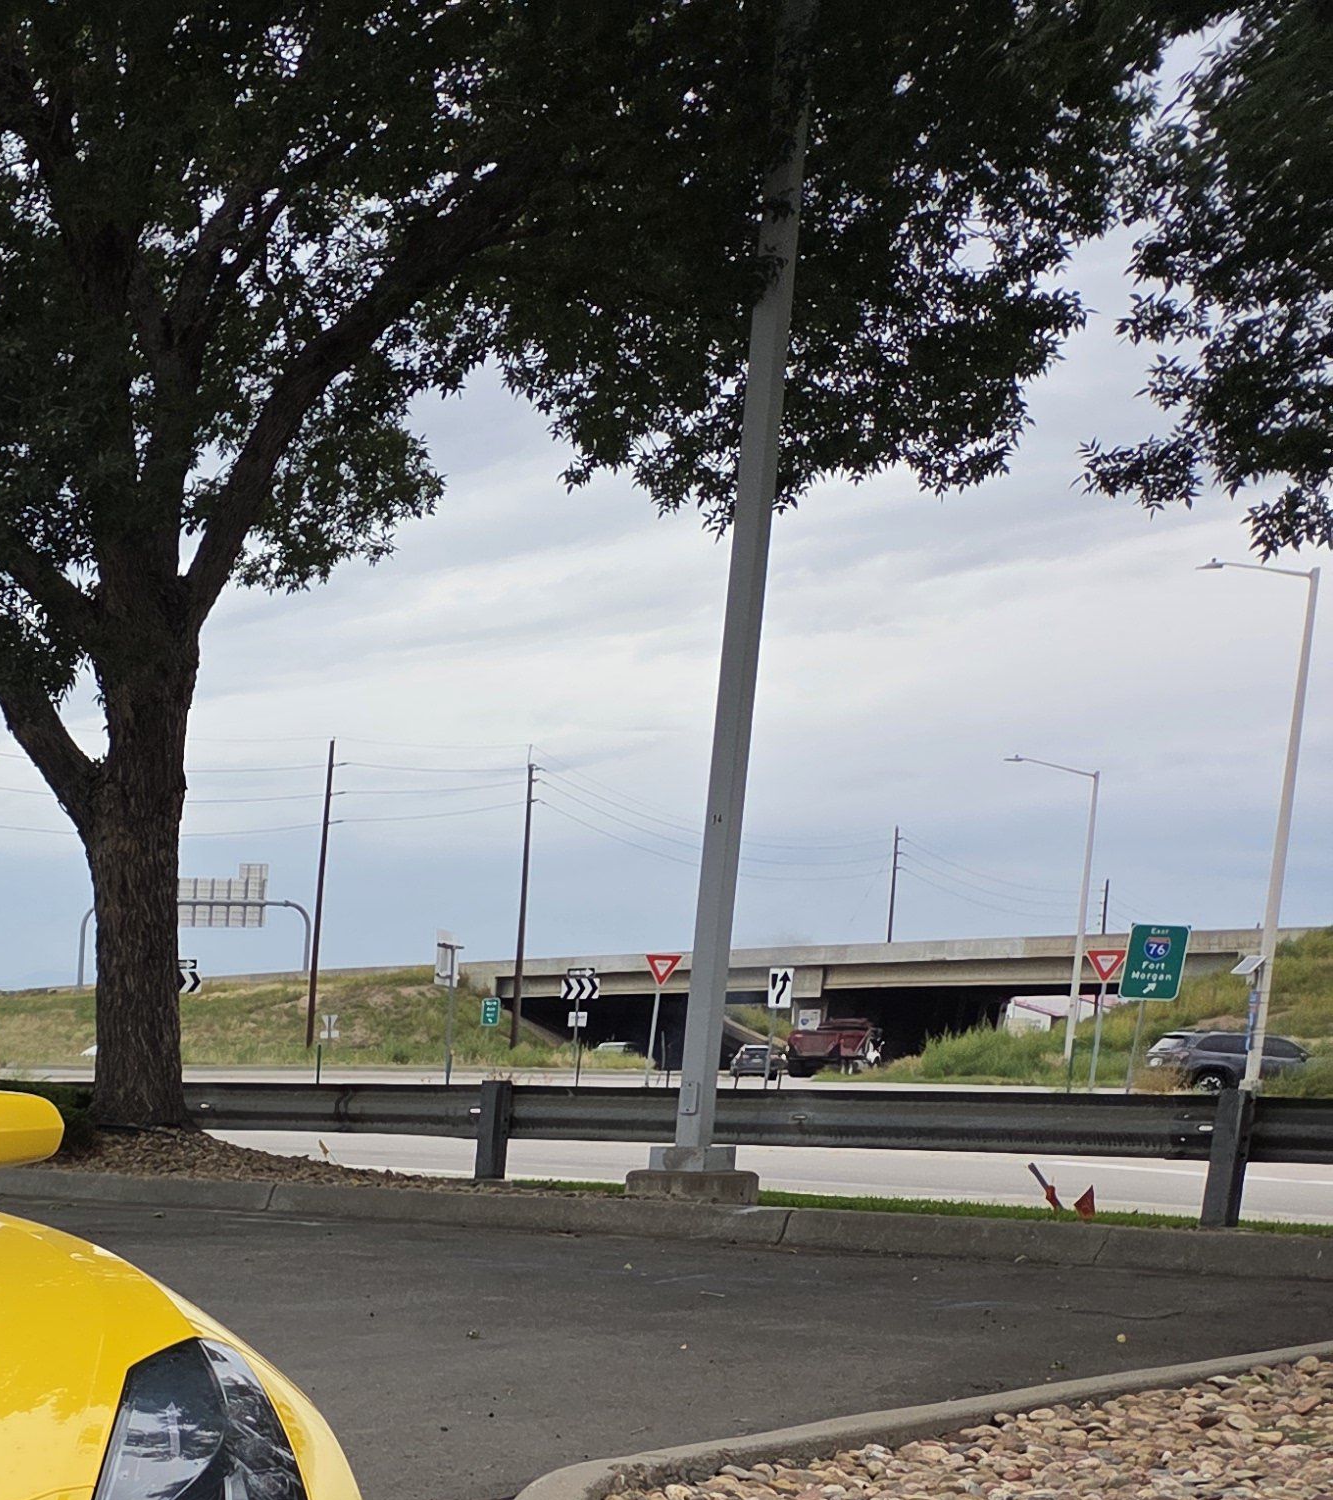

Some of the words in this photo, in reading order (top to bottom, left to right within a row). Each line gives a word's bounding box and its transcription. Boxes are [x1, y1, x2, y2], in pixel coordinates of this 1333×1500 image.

[1148, 943, 1166, 956] 76
[1141, 960, 1165, 970] Fort
[1131, 970, 1172, 981] Morgan
